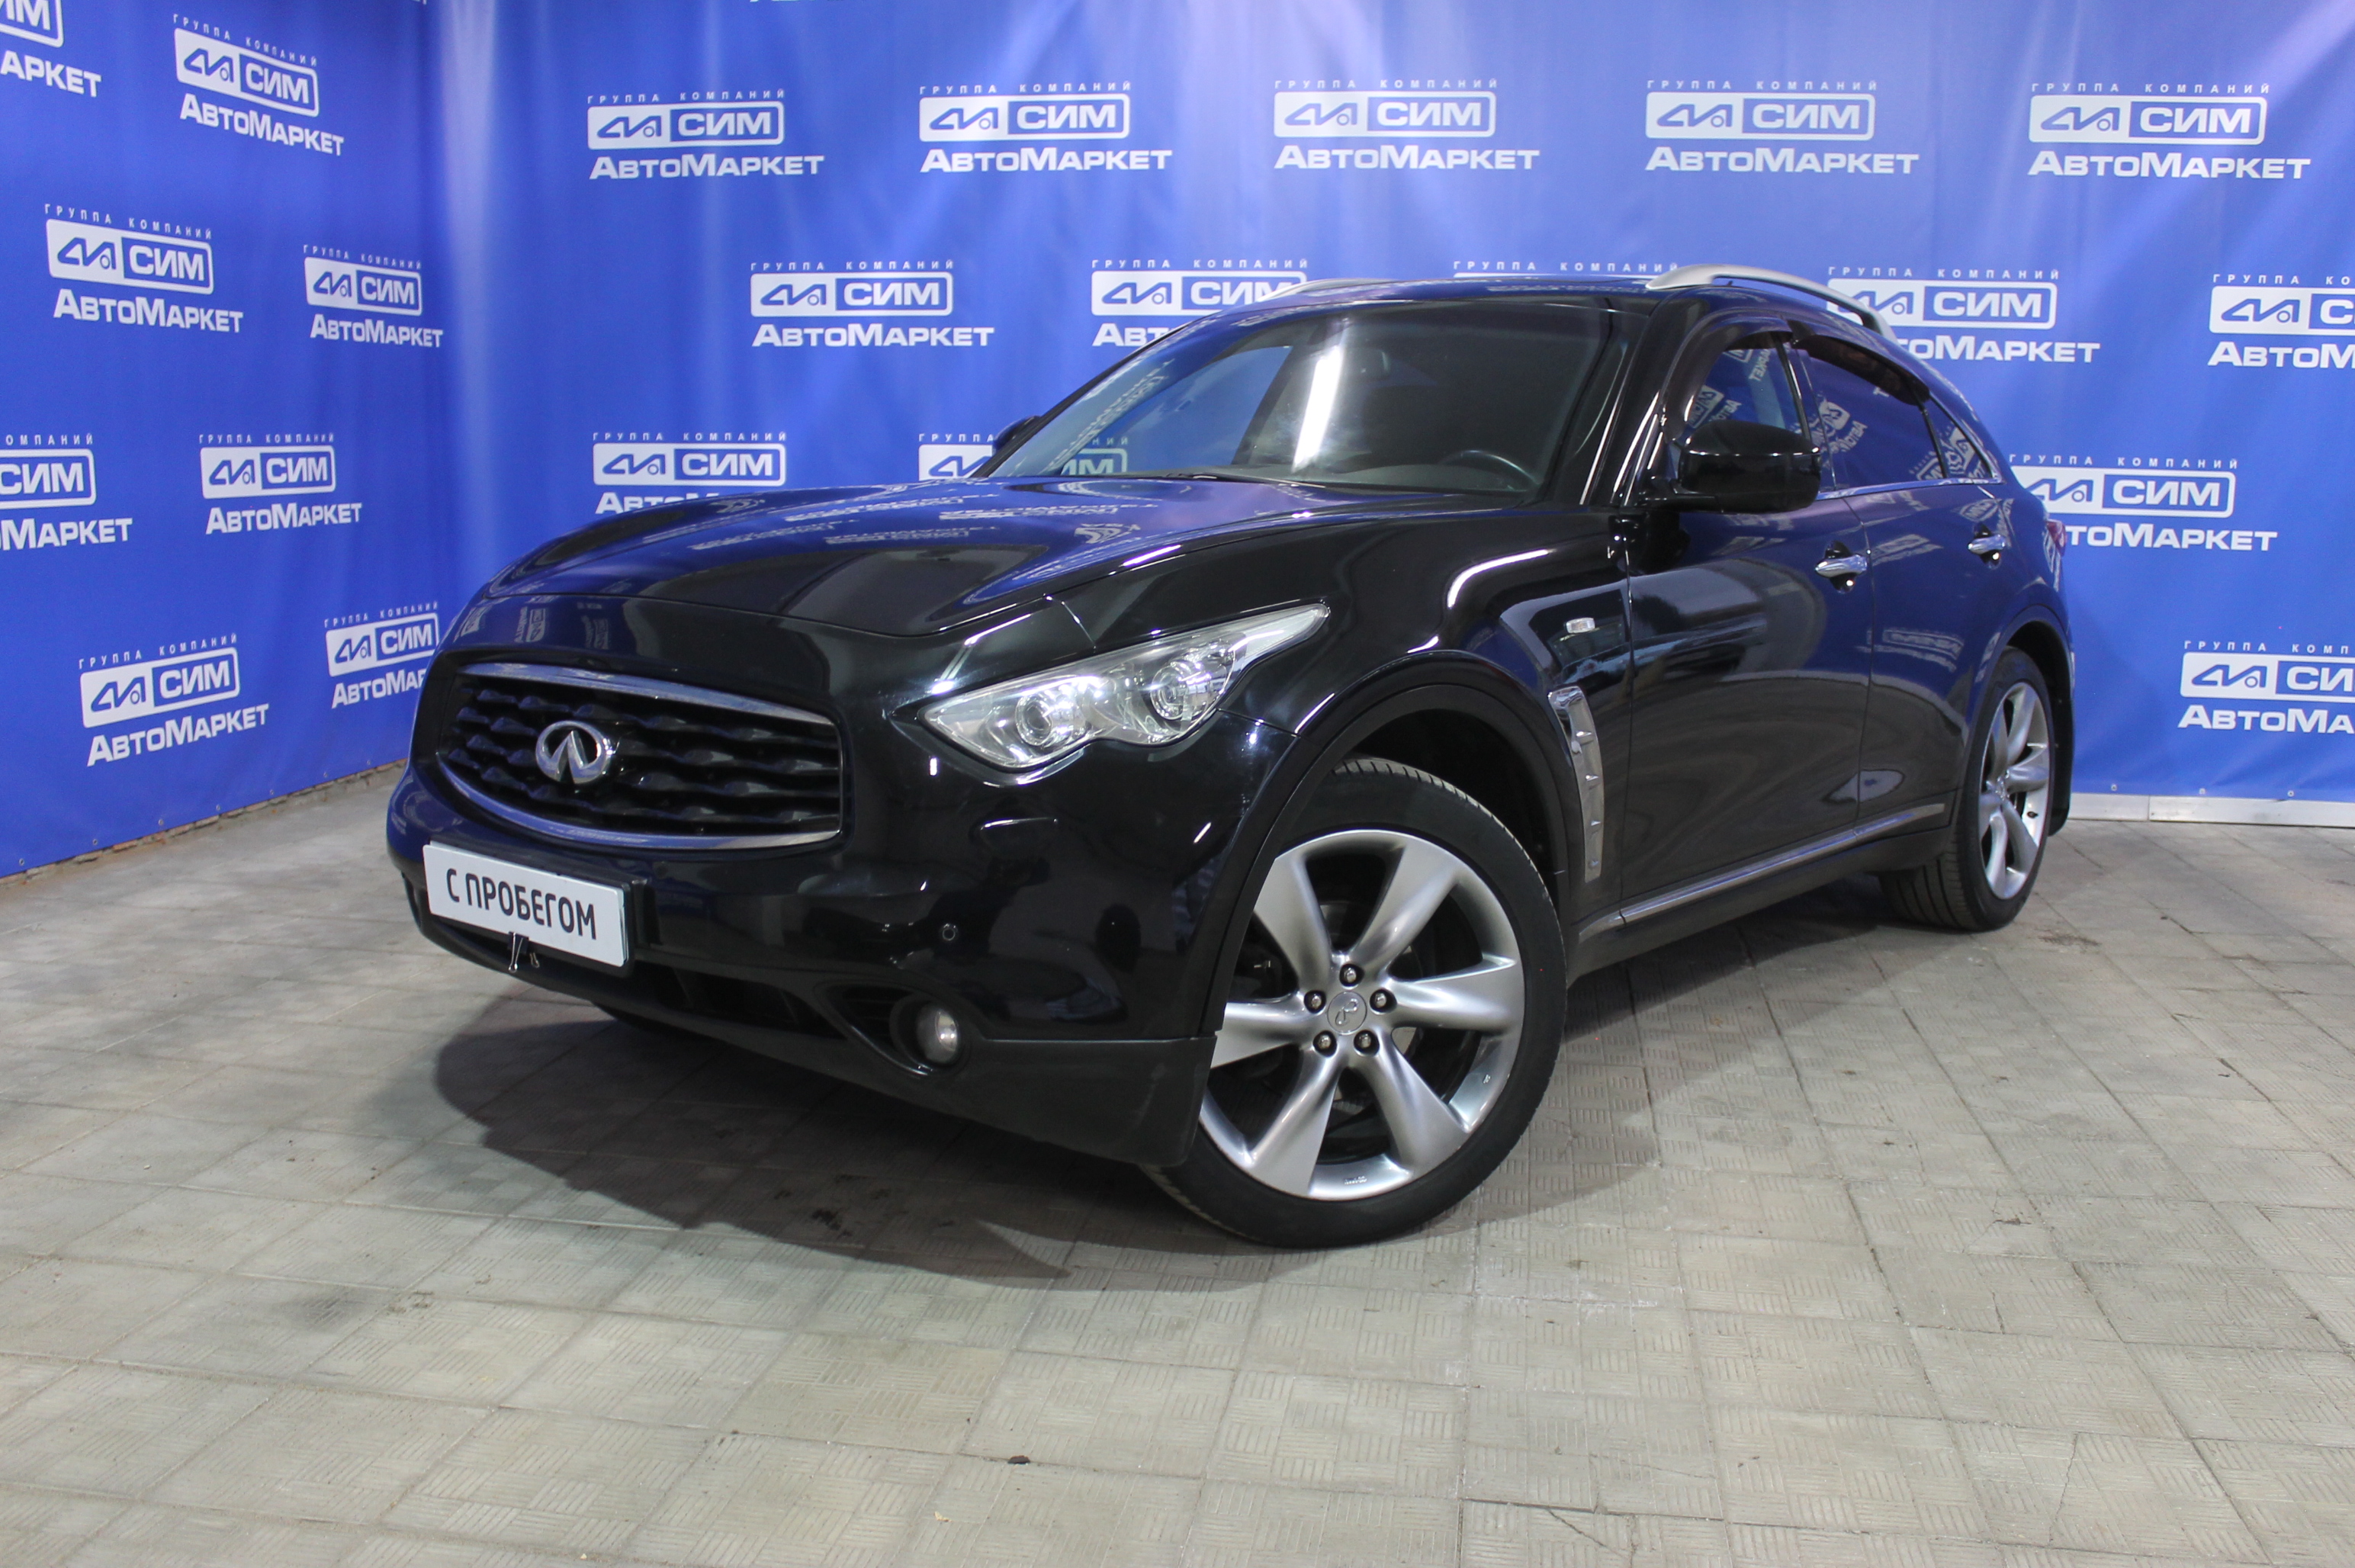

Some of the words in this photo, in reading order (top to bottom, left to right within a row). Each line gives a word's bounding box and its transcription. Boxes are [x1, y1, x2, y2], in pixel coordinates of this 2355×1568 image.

[173, 13, 230, 40] ГРУППА
[246, 37, 316, 66] КОМПАНИЙ
[245, 62, 309, 104] СИМ
[920, 84, 998, 95] ГРУППА
[1019, 80, 1131, 92] КОМПАНИЙ
[1274, 79, 1356, 89] ГРУППА
[1379, 79, 1496, 88] КОМПАНИЙ
[1647, 79, 1731, 89] ГРУППА
[1756, 80, 1877, 90] КОМПАНИЙ
[2031, 82, 2119, 92] ГРУППА
[2145, 82, 2271, 95] КОМПАНИЙ
[587, 93, 659, 104] ГРУППА
[680, 88, 784, 101] КОМПАНИЙ
[678, 111, 771, 137] СИМ
[1017, 104, 1116, 130] СИМ
[1377, 101, 1481, 126] СИМ
[1753, 103, 1861, 130] СИМ
[2140, 107, 2252, 133] СИМ
[44, 203, 111, 223] ГРУППА
[128, 217, 211, 239] КОМПАНИЙ
[129, 244, 204, 281] СИМ
[303, 244, 349, 259] ГРУППА
[361, 253, 420, 269] КОМПАНИЙ
[750, 262, 824, 271] ГРУППА
[846, 259, 953, 270] КОМПАНИЙ
[1091, 259, 1171, 268] ГРУППА
[1194, 259, 1307, 268] КОМПАНИЙ
[1454, 260, 1536, 270] ГРУППА
[1829, 266, 1913, 277] ГРУППА
[1938, 268, 2059, 280] КОМПАНИЙ
[2213, 273, 2299, 284] ГРУППА
[361, 275, 415, 305] СИМ
[843, 281, 940, 306] СИМ
[1933, 291, 2042, 318] СИМ
[198, 434, 252, 444] ГРУППА
[265, 433, 333, 443] КОМПАНИЙ
[593, 432, 663, 441] ГРУППА
[683, 431, 786, 442] КОМПАНИЙ
[265, 456, 328, 484] СИМ
[682, 453, 773, 477] СИМ
[2009, 454, 2093, 465] ГРУППА
[2118, 457, 2238, 469] КОМПАНИЙ
[2112, 479, 2221, 506] СИМ
[323, 613, 368, 628] ГРУППА
[380, 602, 438, 619] КОМПАНИЙ
[380, 623, 432, 655] СИМ
[2184, 640, 2267, 651] ГРУППА
[79, 650, 142, 670] ГРУППА
[159, 634, 236, 656] КОМПАНИЙ
[159, 660, 230, 699] СИМ
[446, 869, 460, 902] С
[465, 873, 596, 940] ПРОБЕГОМ
